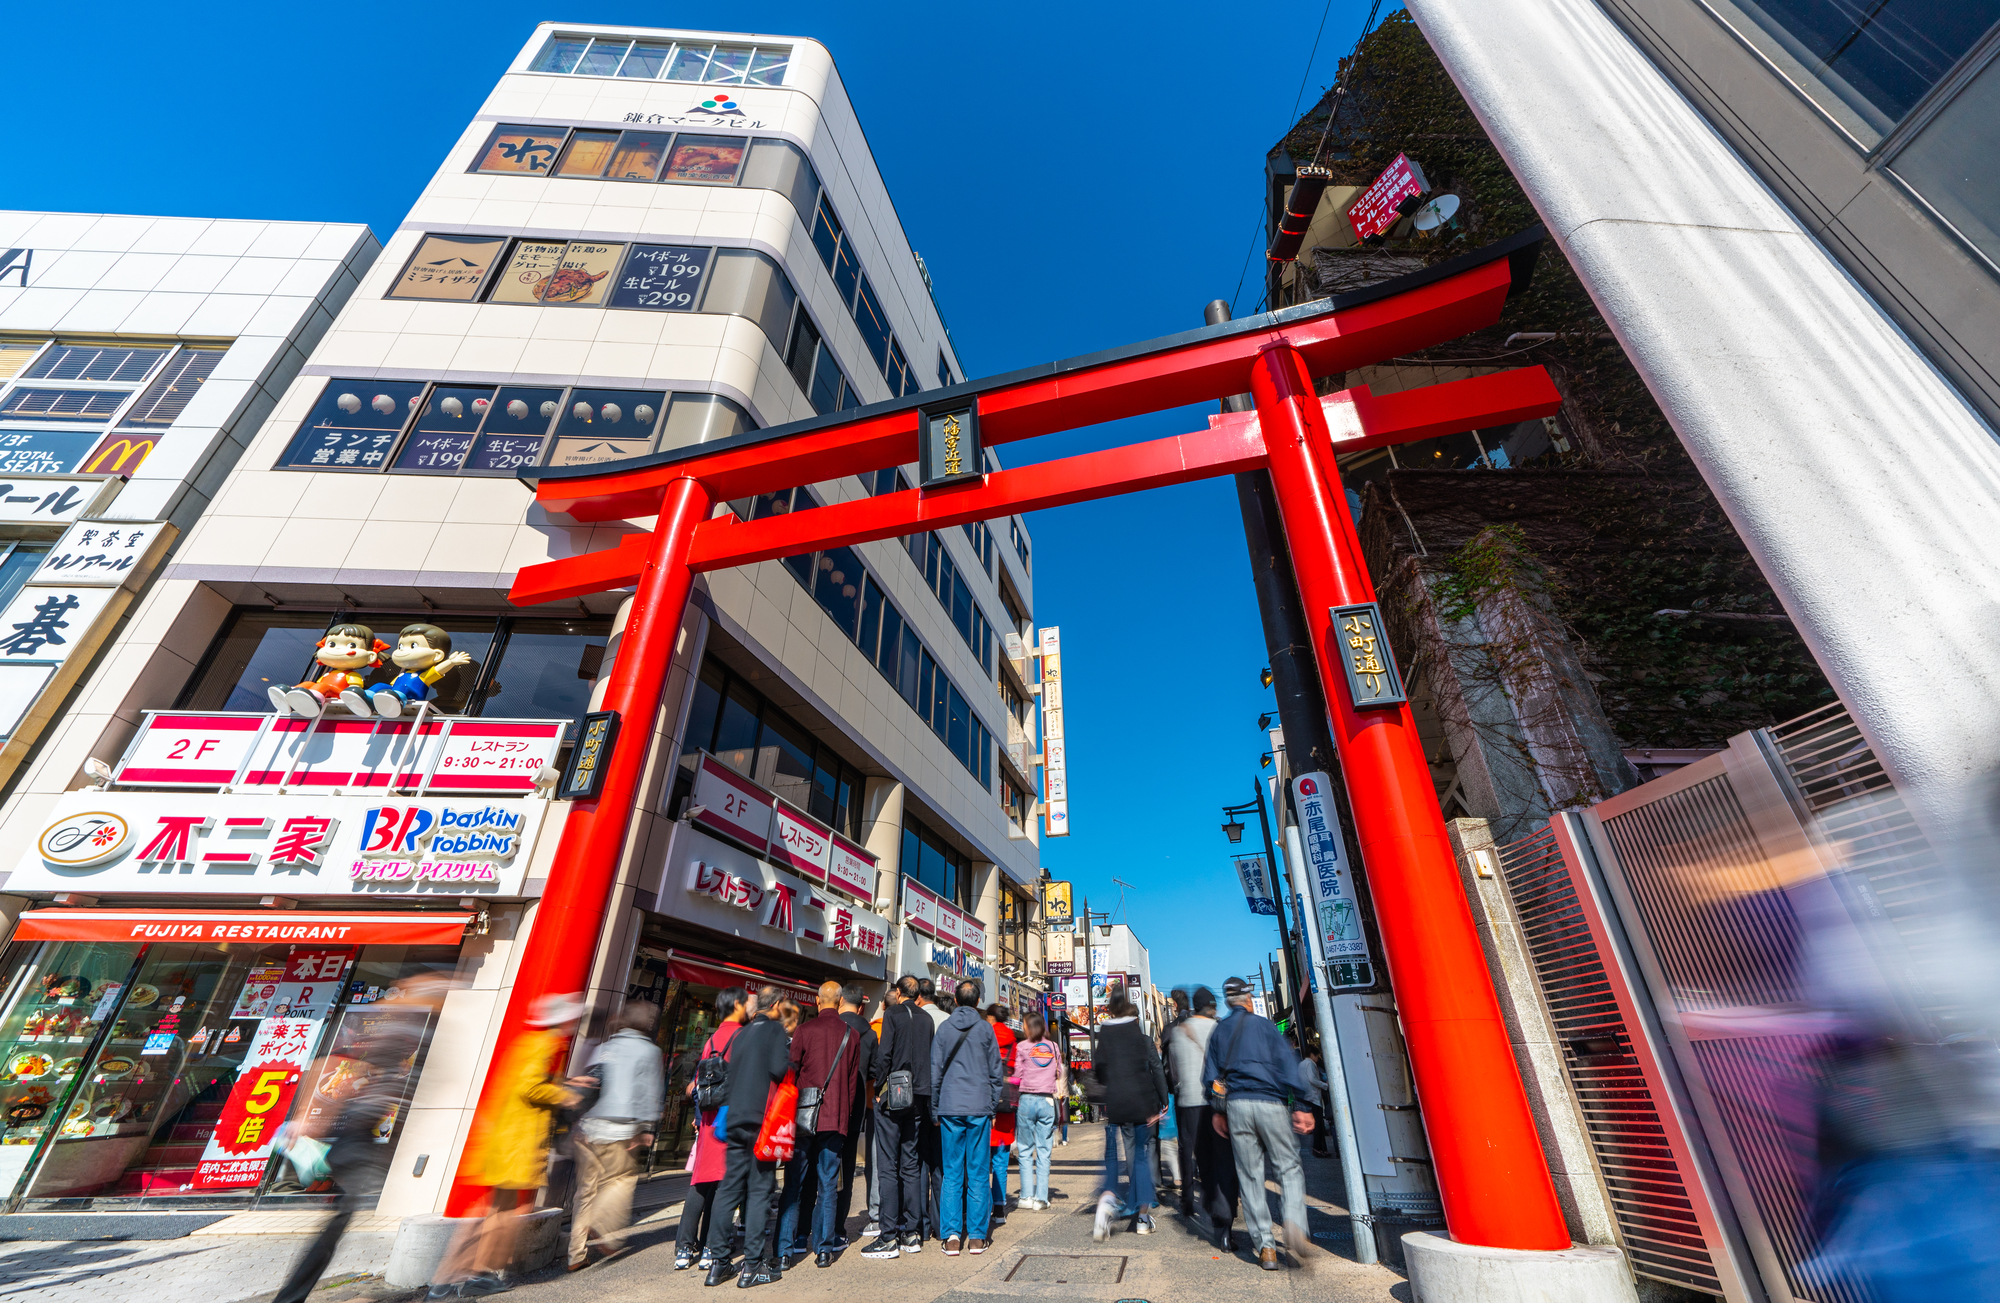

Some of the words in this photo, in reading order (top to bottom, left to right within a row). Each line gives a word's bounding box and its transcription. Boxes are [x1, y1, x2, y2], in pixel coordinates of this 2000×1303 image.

[622, 112, 767, 129] 鎌倉マークビル
[1349, 157, 1404, 217] TURKISH
[1358, 172, 1400, 217] CUISINE
[1356, 171, 1413, 232] トルコ料理
[634, 251, 691, 263] ハイボール
[407, 272, 480, 284] ミライザカ
[622, 276, 681, 290] 生ビール
[324, 432, 392, 447] ランチ
[416, 438, 470, 450] ハイボール
[486, 439, 540, 453] 生ビール
[943, 414, 963, 475] 八幡宮近道
[12, 450, 55, 460] TOTAL
[311, 448, 385, 465] 営業中
[0, 460, 64, 473] SEATS
[77, 529, 145, 548] 喫茶室
[43, 553, 135, 572] ルノアール
[0, 594, 80, 655] 碁
[1344, 616, 1387, 697] 小町通り
[166, 738, 221, 760] 2F
[470, 740, 529, 753] レストラン
[577, 720, 606, 788] 小町通り
[723, 793, 748, 818] 2F
[360, 806, 433, 852] BR
[135, 816, 330, 864] 不二家
[779, 821, 823, 857] レストラン
[1305, 801, 1327, 834] 赤尾
[1317, 862, 1341, 898] 医院
[351, 861, 412, 878] サーティワン
[415, 862, 493, 879] アイスクリーム
[696, 864, 764, 908] レストラン
[769, 881, 853, 951] 不二家
[857, 924, 884, 957] 洋菓子
[130, 924, 203, 938] FUJIYA
[211, 926, 350, 939] RESTAURANT
[292, 955, 347, 980] 本日
[284, 1009, 316, 1019] POINT
[272, 1023, 311, 1040] 楽天
[257, 1040, 308, 1057] ポイント
[245, 1070, 288, 1114] 5
[235, 1116, 266, 1145] 倍
